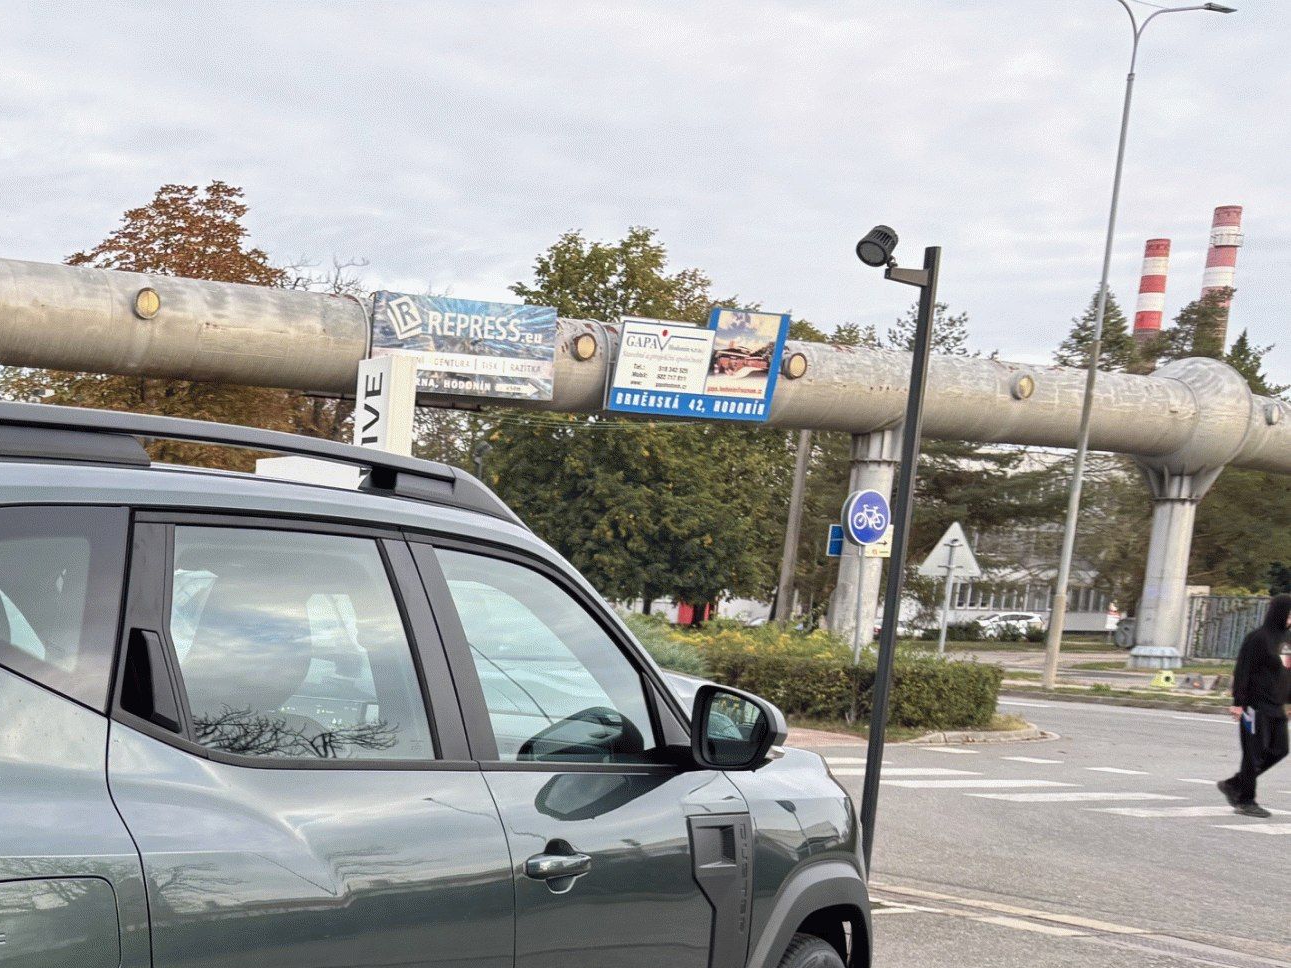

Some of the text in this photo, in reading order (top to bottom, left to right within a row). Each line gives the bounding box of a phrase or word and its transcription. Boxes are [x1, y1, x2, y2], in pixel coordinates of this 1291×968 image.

[427, 310, 542, 344] REPRESS.eu
[688, 398, 706, 413] 42,
[713, 400, 765, 416] HODONÍN
